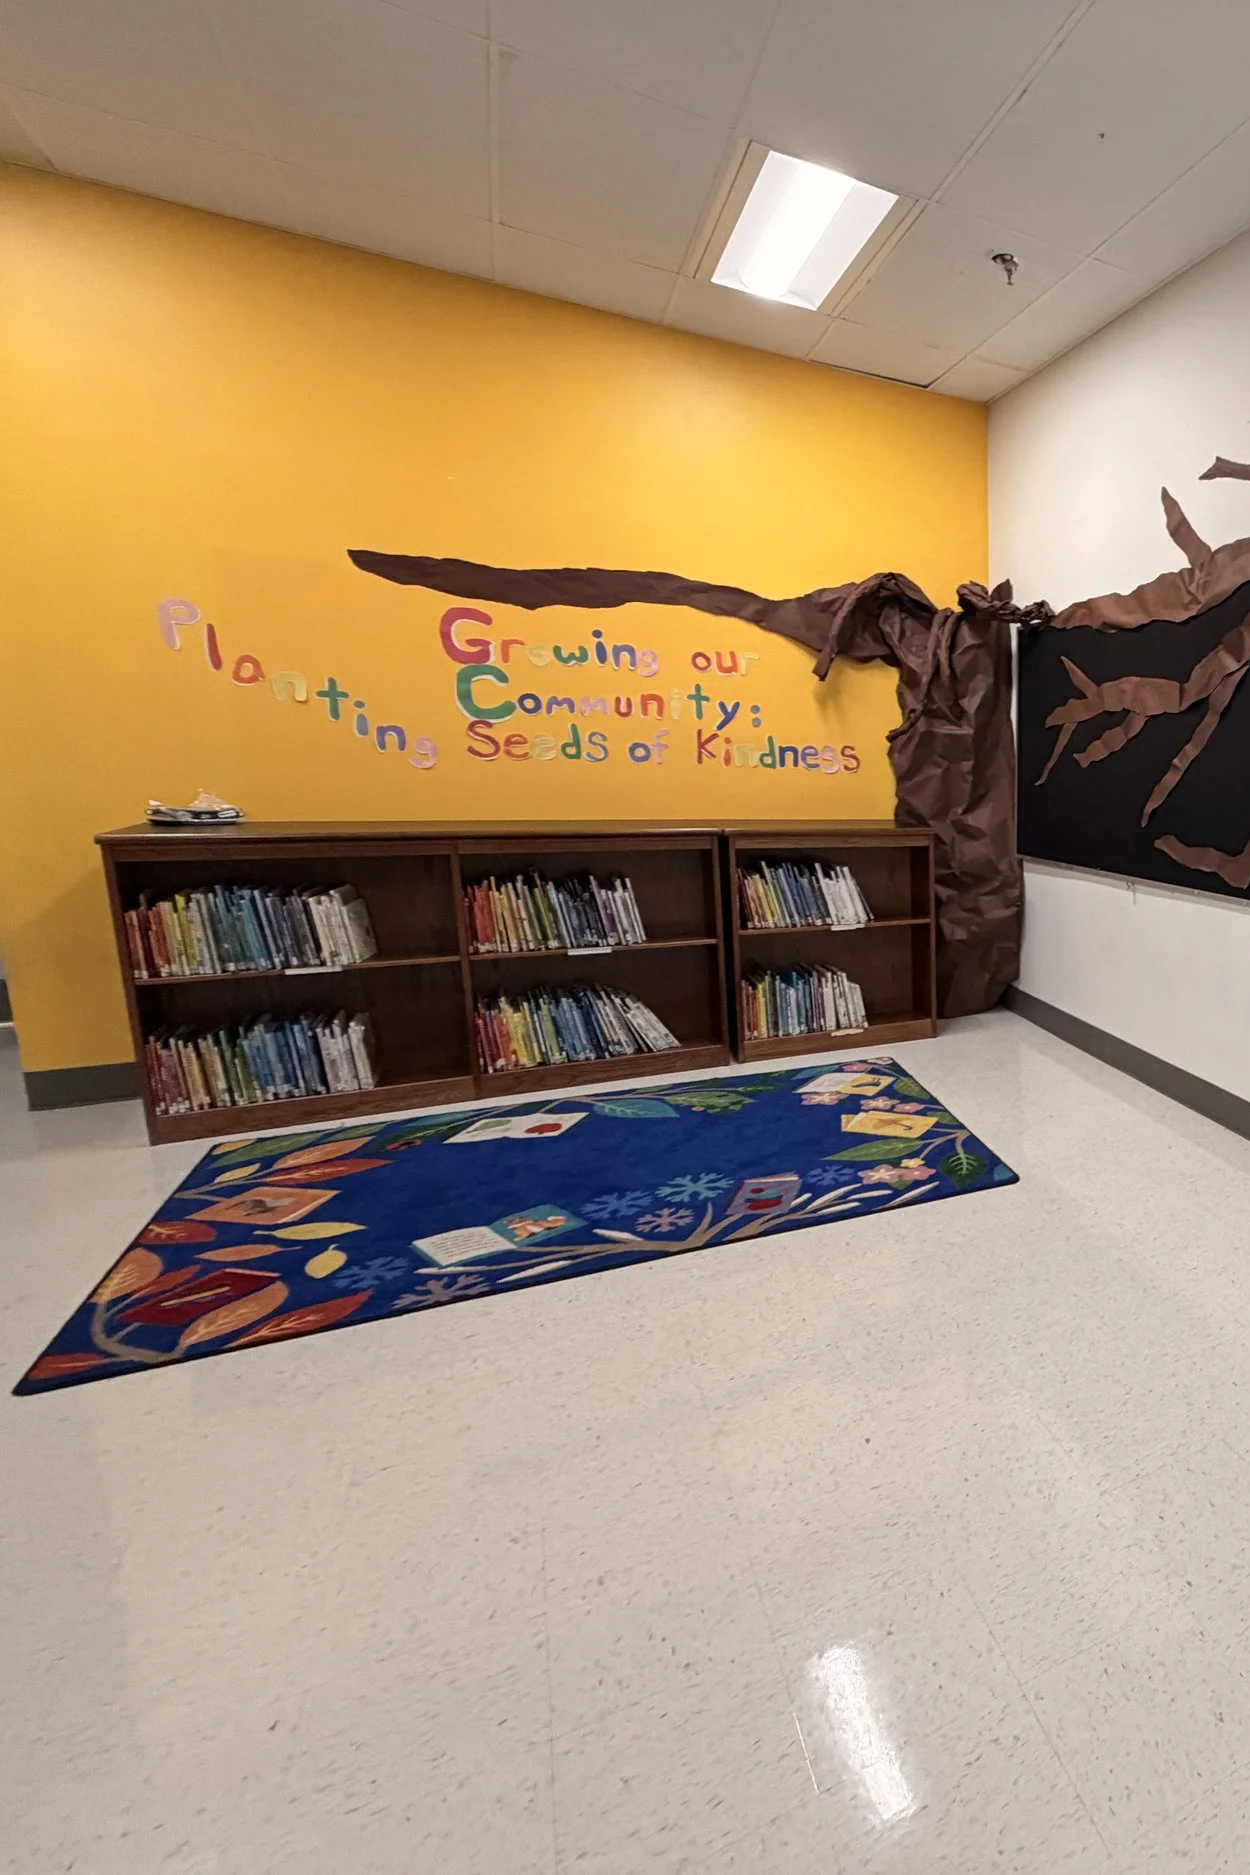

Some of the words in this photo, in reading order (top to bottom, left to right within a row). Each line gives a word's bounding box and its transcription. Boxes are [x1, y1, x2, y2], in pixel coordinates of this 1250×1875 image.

[439, 606, 660, 677] Growing
[691, 648, 760, 677] our
[157, 597, 438, 769] Planting
[466, 719, 609, 761] Seeds
[628, 728, 670, 765] of
[696, 728, 861, 774] Kindness
[455, 664, 761, 731] Community:
